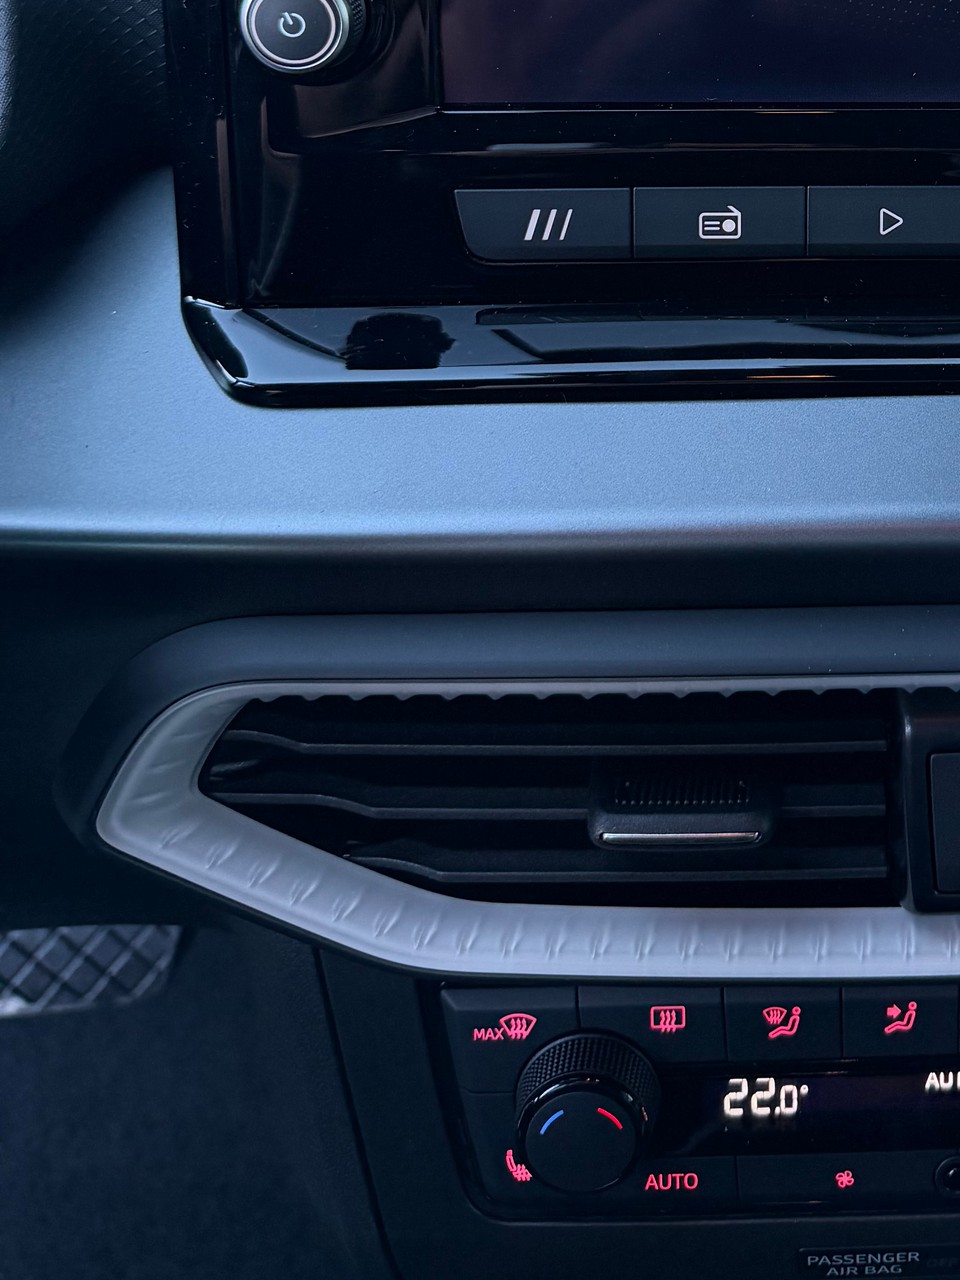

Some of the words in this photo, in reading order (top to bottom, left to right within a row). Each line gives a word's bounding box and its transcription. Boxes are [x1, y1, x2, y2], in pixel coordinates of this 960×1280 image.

[473, 1028, 504, 1041] MAX
[645, 1173, 698, 1190] AUTO
[807, 1251, 920, 1266] PASSENGER
[826, 1266, 858, 1276] AIR
[864, 1264, 902, 1275] BAG
